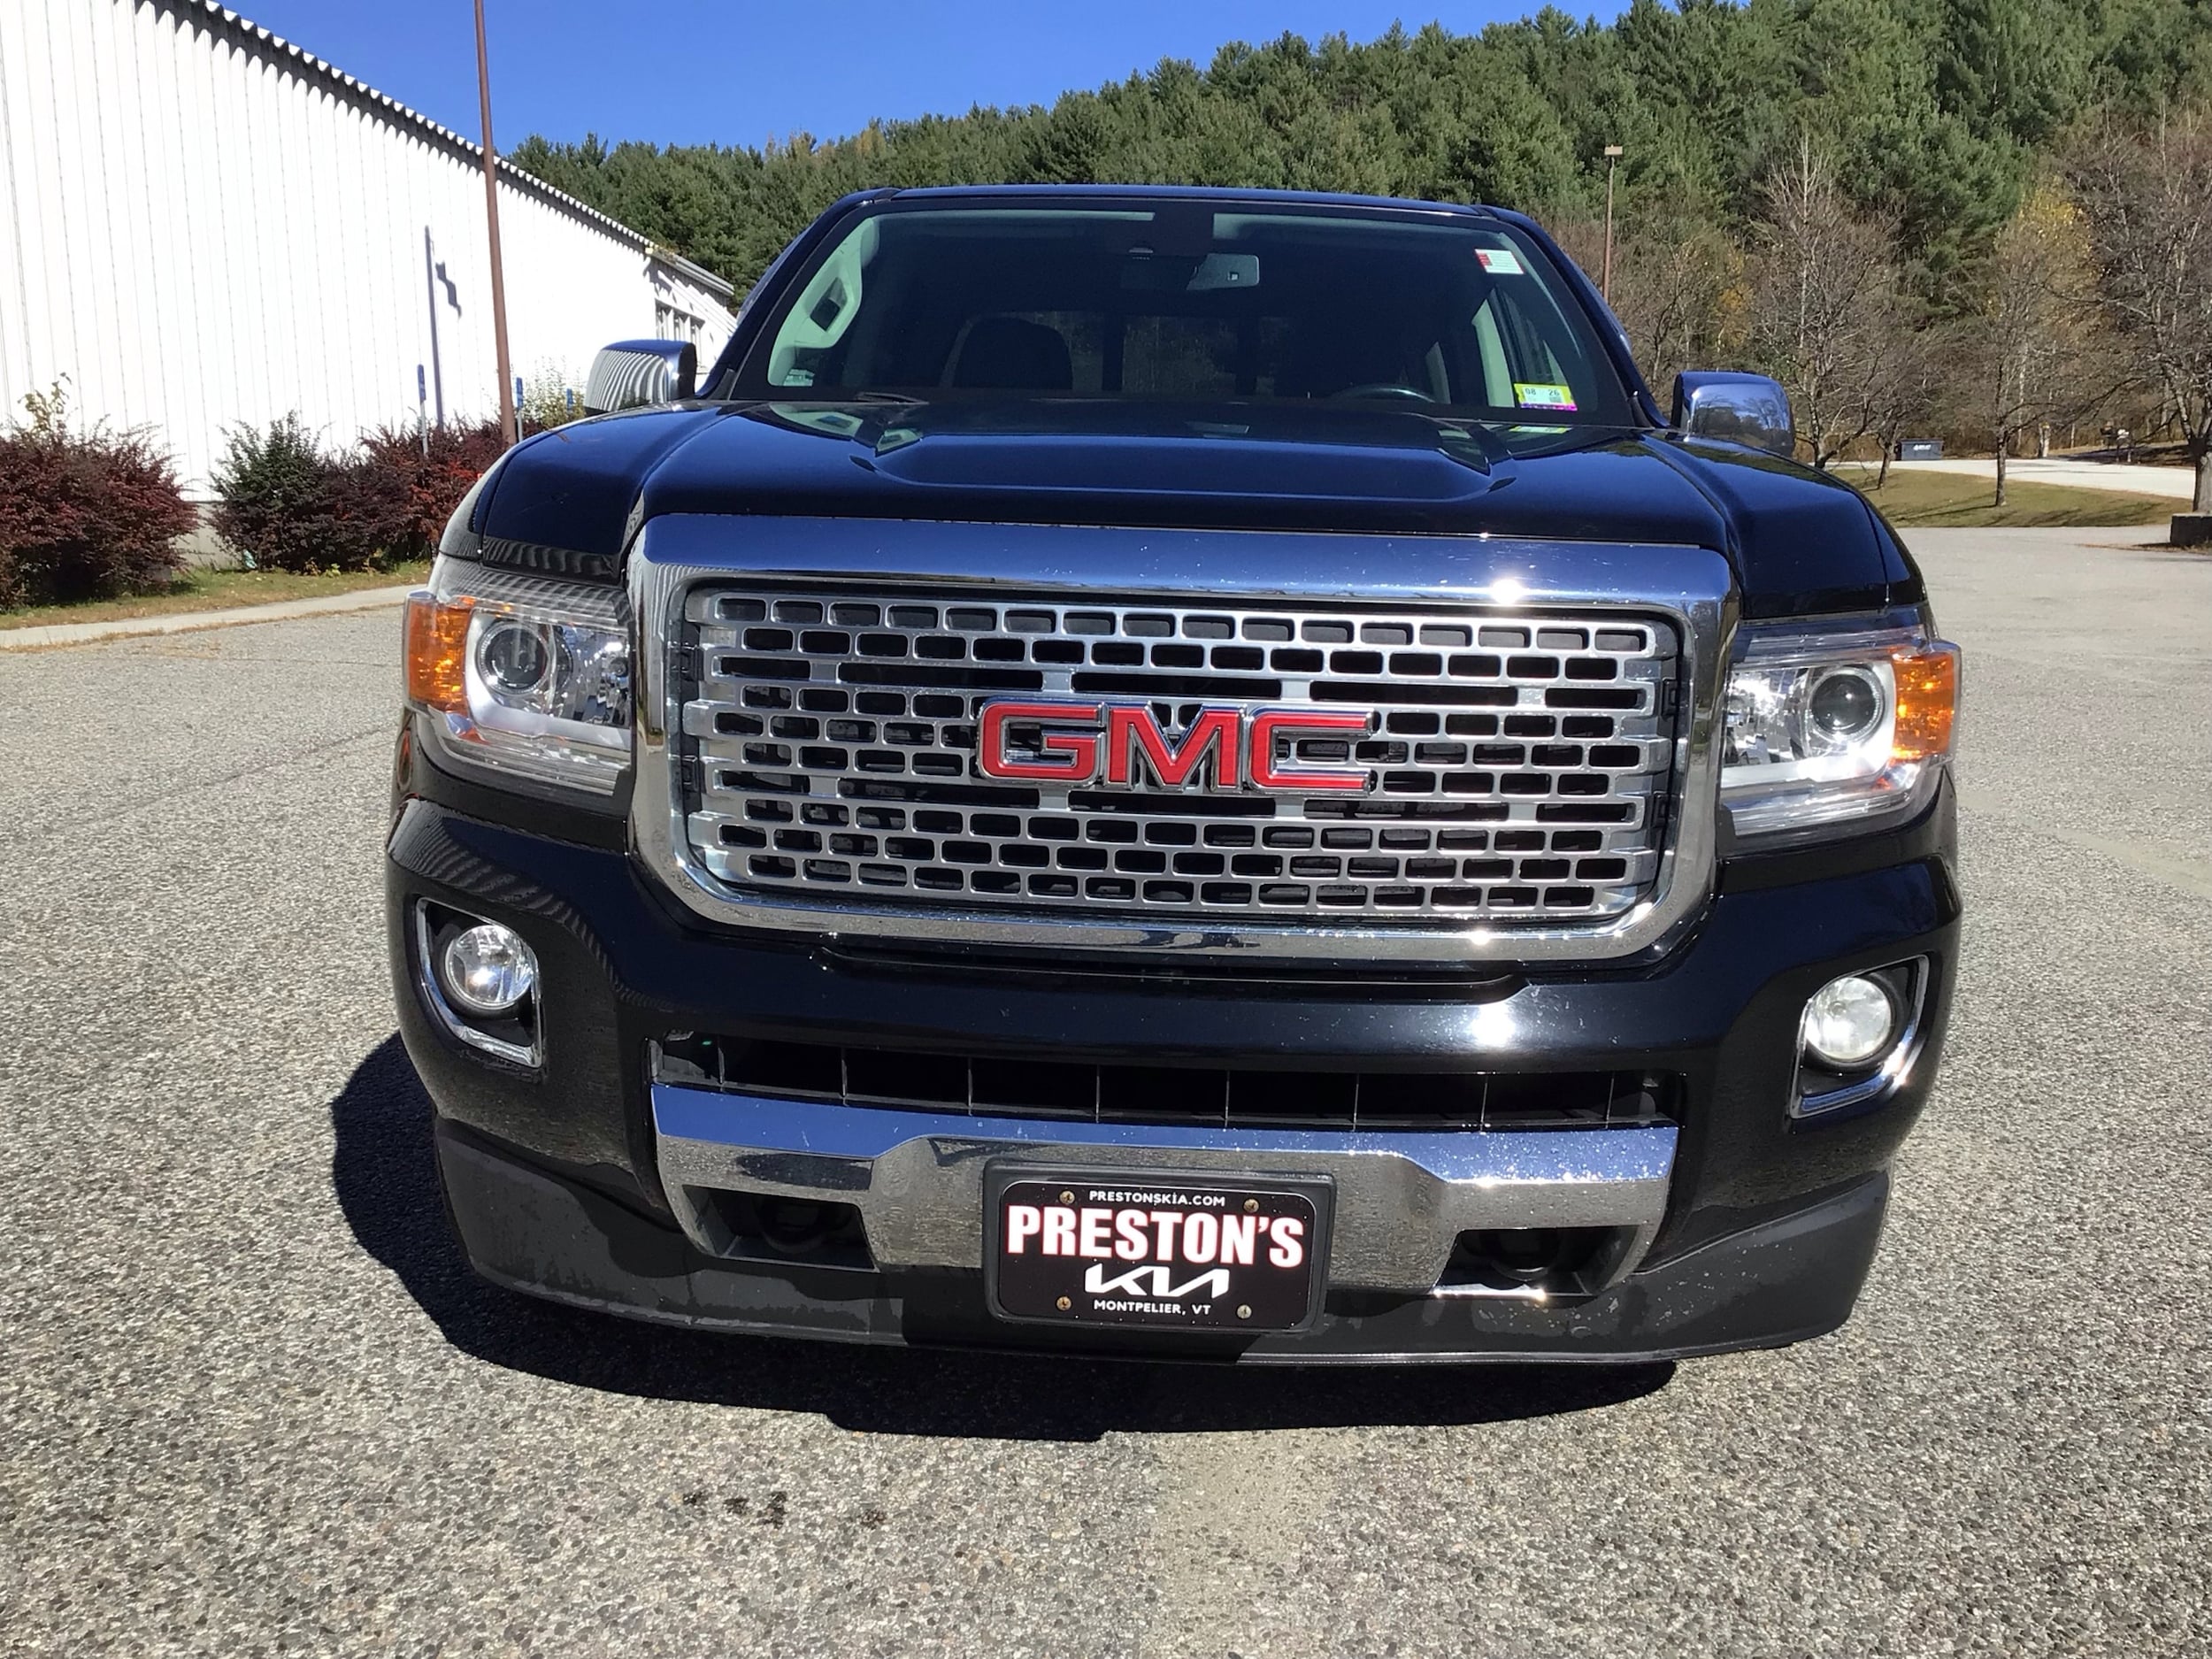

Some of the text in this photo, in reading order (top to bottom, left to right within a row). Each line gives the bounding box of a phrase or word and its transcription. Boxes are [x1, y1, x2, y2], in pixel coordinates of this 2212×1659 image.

[978, 701, 1374, 795] GMC
[1088, 1189, 1226, 1207] PRESTONSKIA.COM
[1006, 1204, 1304, 1269] PRESTON'S
[1084, 1262, 1231, 1300] KIA
[1093, 1299, 1211, 1316] MONTPELIER, VT
